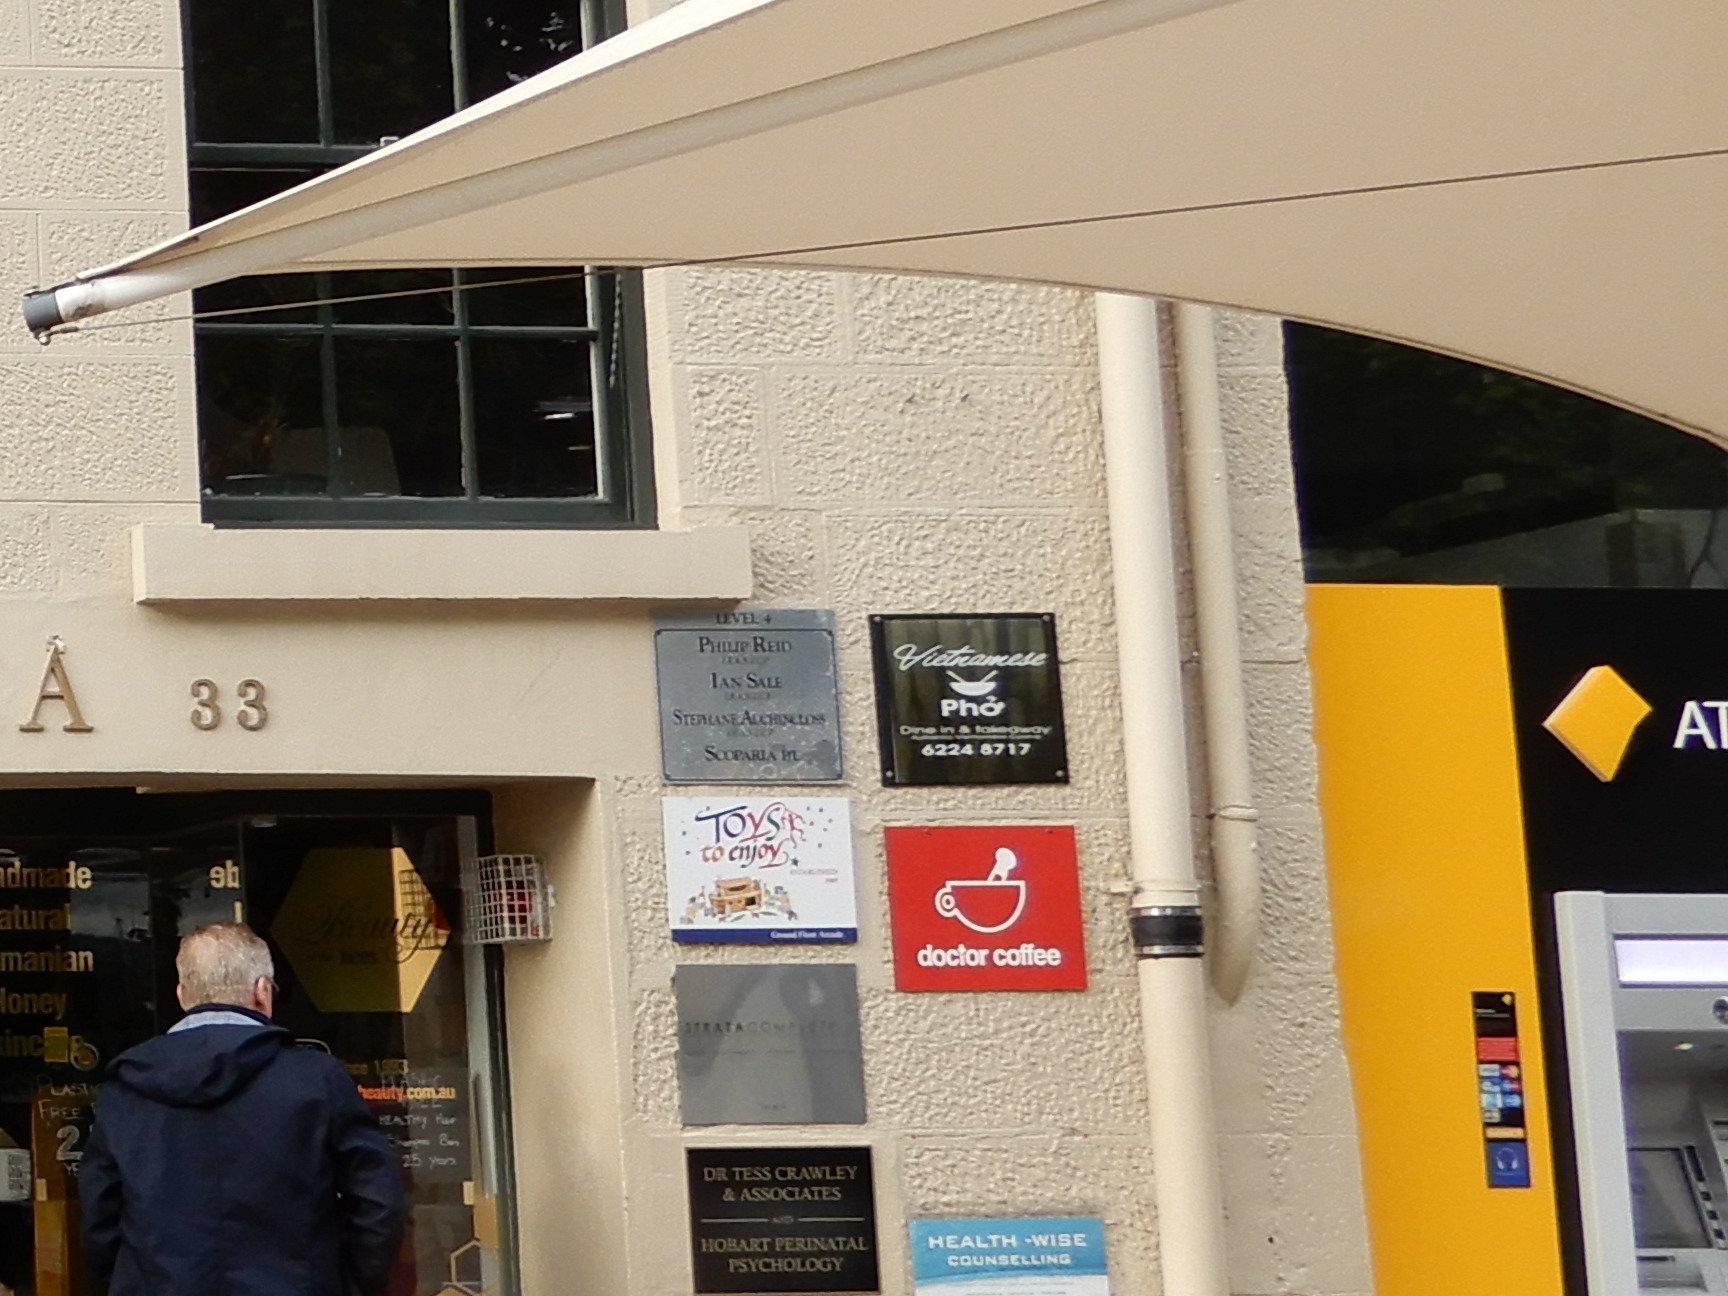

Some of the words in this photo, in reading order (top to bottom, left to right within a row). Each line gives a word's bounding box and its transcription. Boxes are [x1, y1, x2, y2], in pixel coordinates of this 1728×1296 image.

[716, 613, 759, 624] LEVEL
[893, 644, 1049, 671] Vietnamese
[189, 679, 268, 732] 33
[959, 725, 970, 733] &
[921, 744, 974, 756] 6224
[980, 743, 1031, 755] 8717
[700, 845, 724, 862] to
[729, 842, 789, 869] enjoy
[917, 944, 989, 966] doctor
[993, 943, 1062, 966] coffee
[703, 1167, 728, 1181] DR
[732, 1167, 770, 1181] TESS
[775, 1166, 858, 1181] CRAWLEY
[723, 1188, 734, 1201] &
[741, 1187, 842, 1201] ASSOCIATES
[701, 1238, 773, 1252] HOBART
[775, 1237, 869, 1252] PERINATAL
[929, 1234, 1017, 1249] HEALTH
[728, 1258, 843, 1273] PSYCHOLOGY
[947, 1254, 1072, 1266] COUNSELLING
